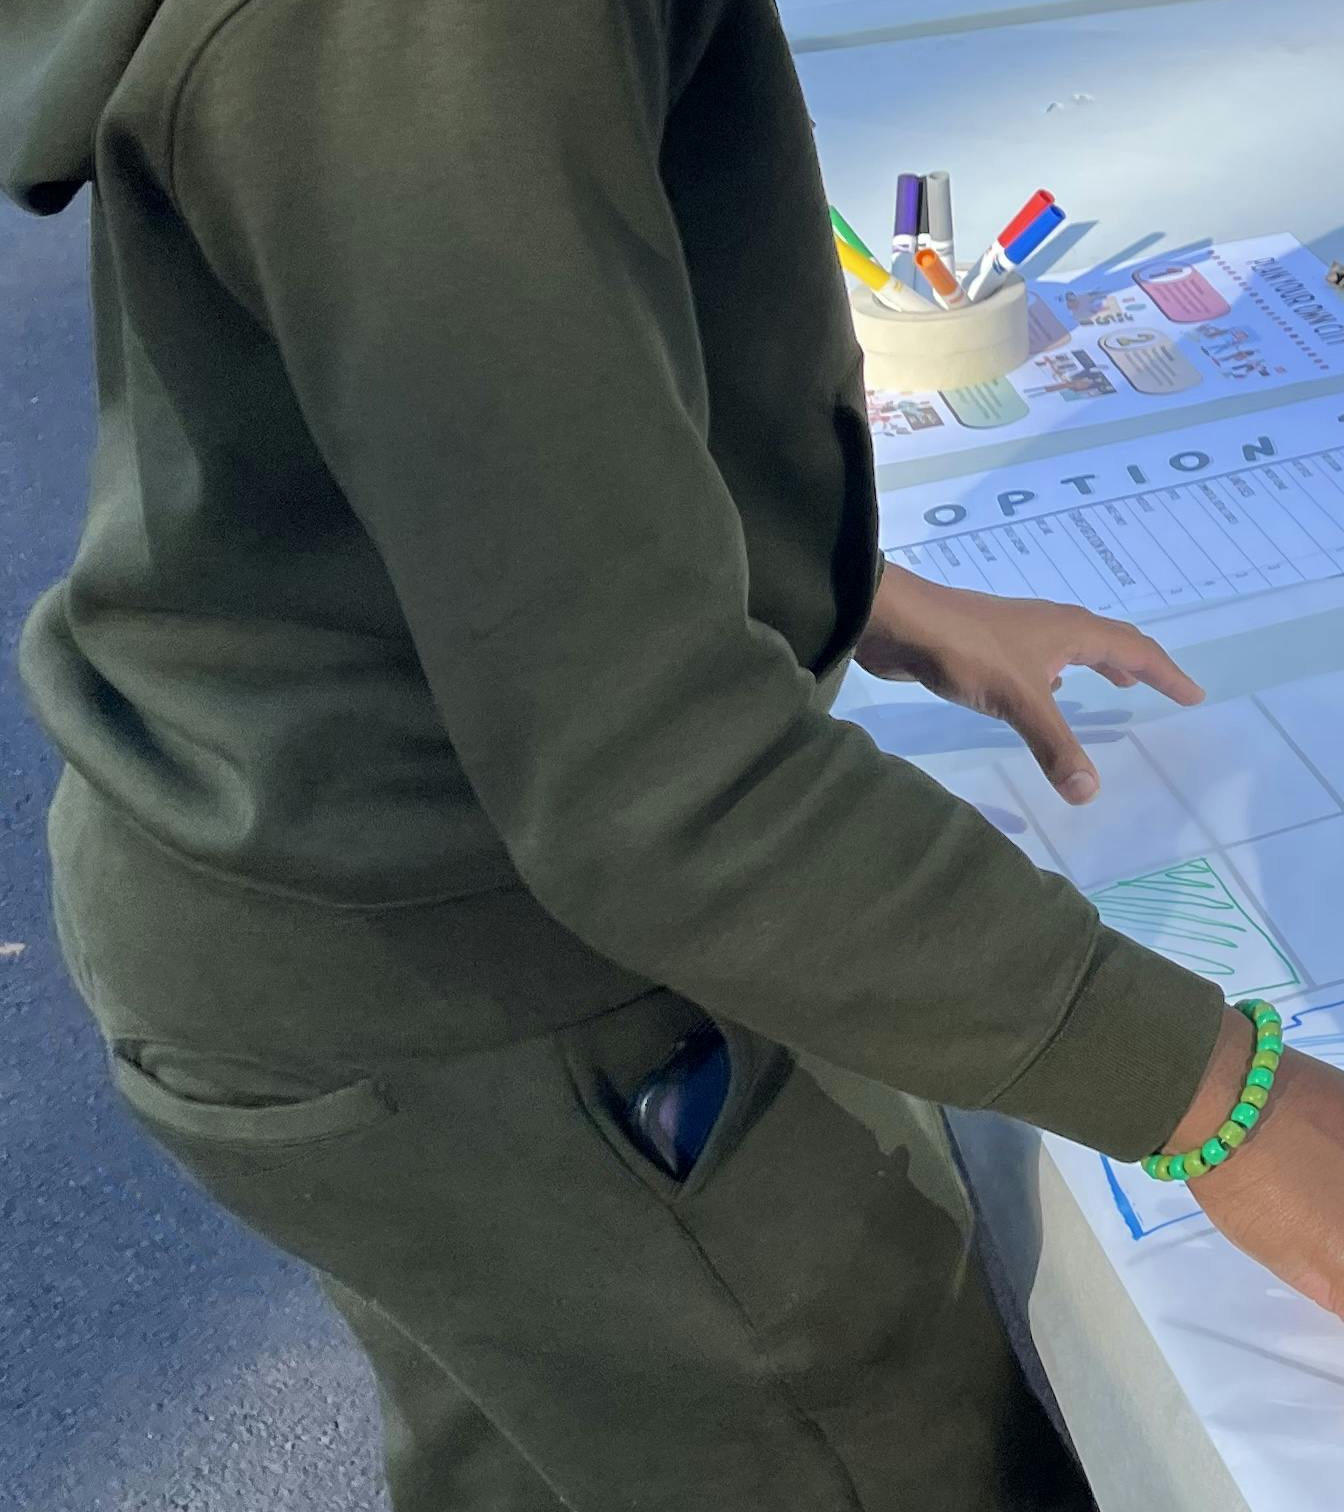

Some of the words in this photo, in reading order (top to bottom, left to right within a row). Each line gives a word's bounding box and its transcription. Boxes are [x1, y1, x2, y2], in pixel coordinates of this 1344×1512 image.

[1246, 257, 1294, 282] PLAN
[1269, 279, 1315, 307] YOUR
[924, 436, 1279, 527] OPTION
